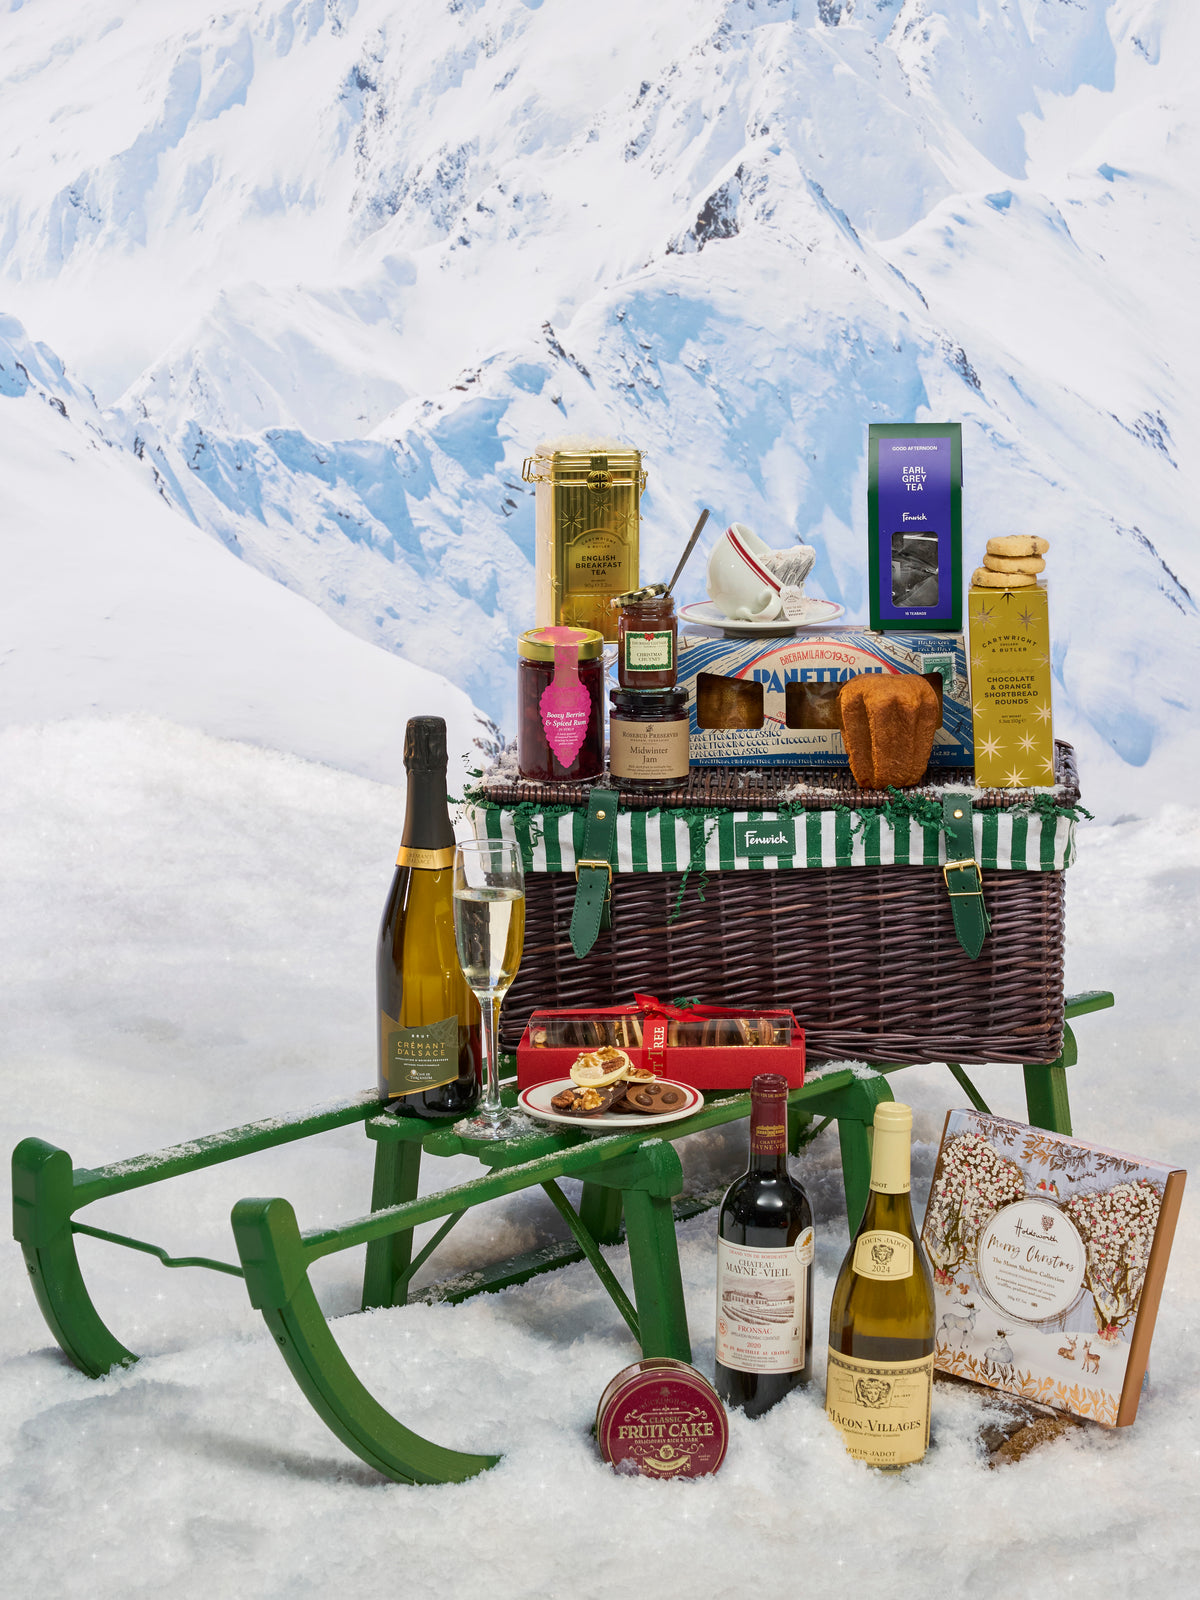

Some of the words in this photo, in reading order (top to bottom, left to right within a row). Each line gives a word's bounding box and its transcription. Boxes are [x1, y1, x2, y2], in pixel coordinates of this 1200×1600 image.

[902, 512, 927, 522] Fenwick
[982, 636, 1037, 648] CARTWRIGHT
[746, 730, 782, 739] CLASSICO
[781, 736, 827, 744] CIOCCOLATO
[733, 747, 768, 755] CLASSICO
[642, 756, 657, 764] Jam
[744, 830, 788, 848] Fenwick
[398, 1041, 445, 1049] CRÉMANT
[648, 1026, 664, 1060] TREE
[1014, 1218, 1058, 1243] Holdsworth
[862, 1238, 881, 1246] LOUIS
[884, 1238, 907, 1249] JADOT
[987, 1234, 1020, 1258] Merry
[1027, 1245, 1075, 1272] Christmas
[739, 1260, 774, 1268] CHATEAU
[1019, 1265, 1038, 1274] Shadow
[1040, 1271, 1064, 1283] Collection
[738, 1325, 772, 1334] FRONSAC
[829, 1408, 920, 1432] MÂCON-VILLAGES
[618, 1424, 666, 1439] FRUIT
[668, 1422, 714, 1437] CAKE
